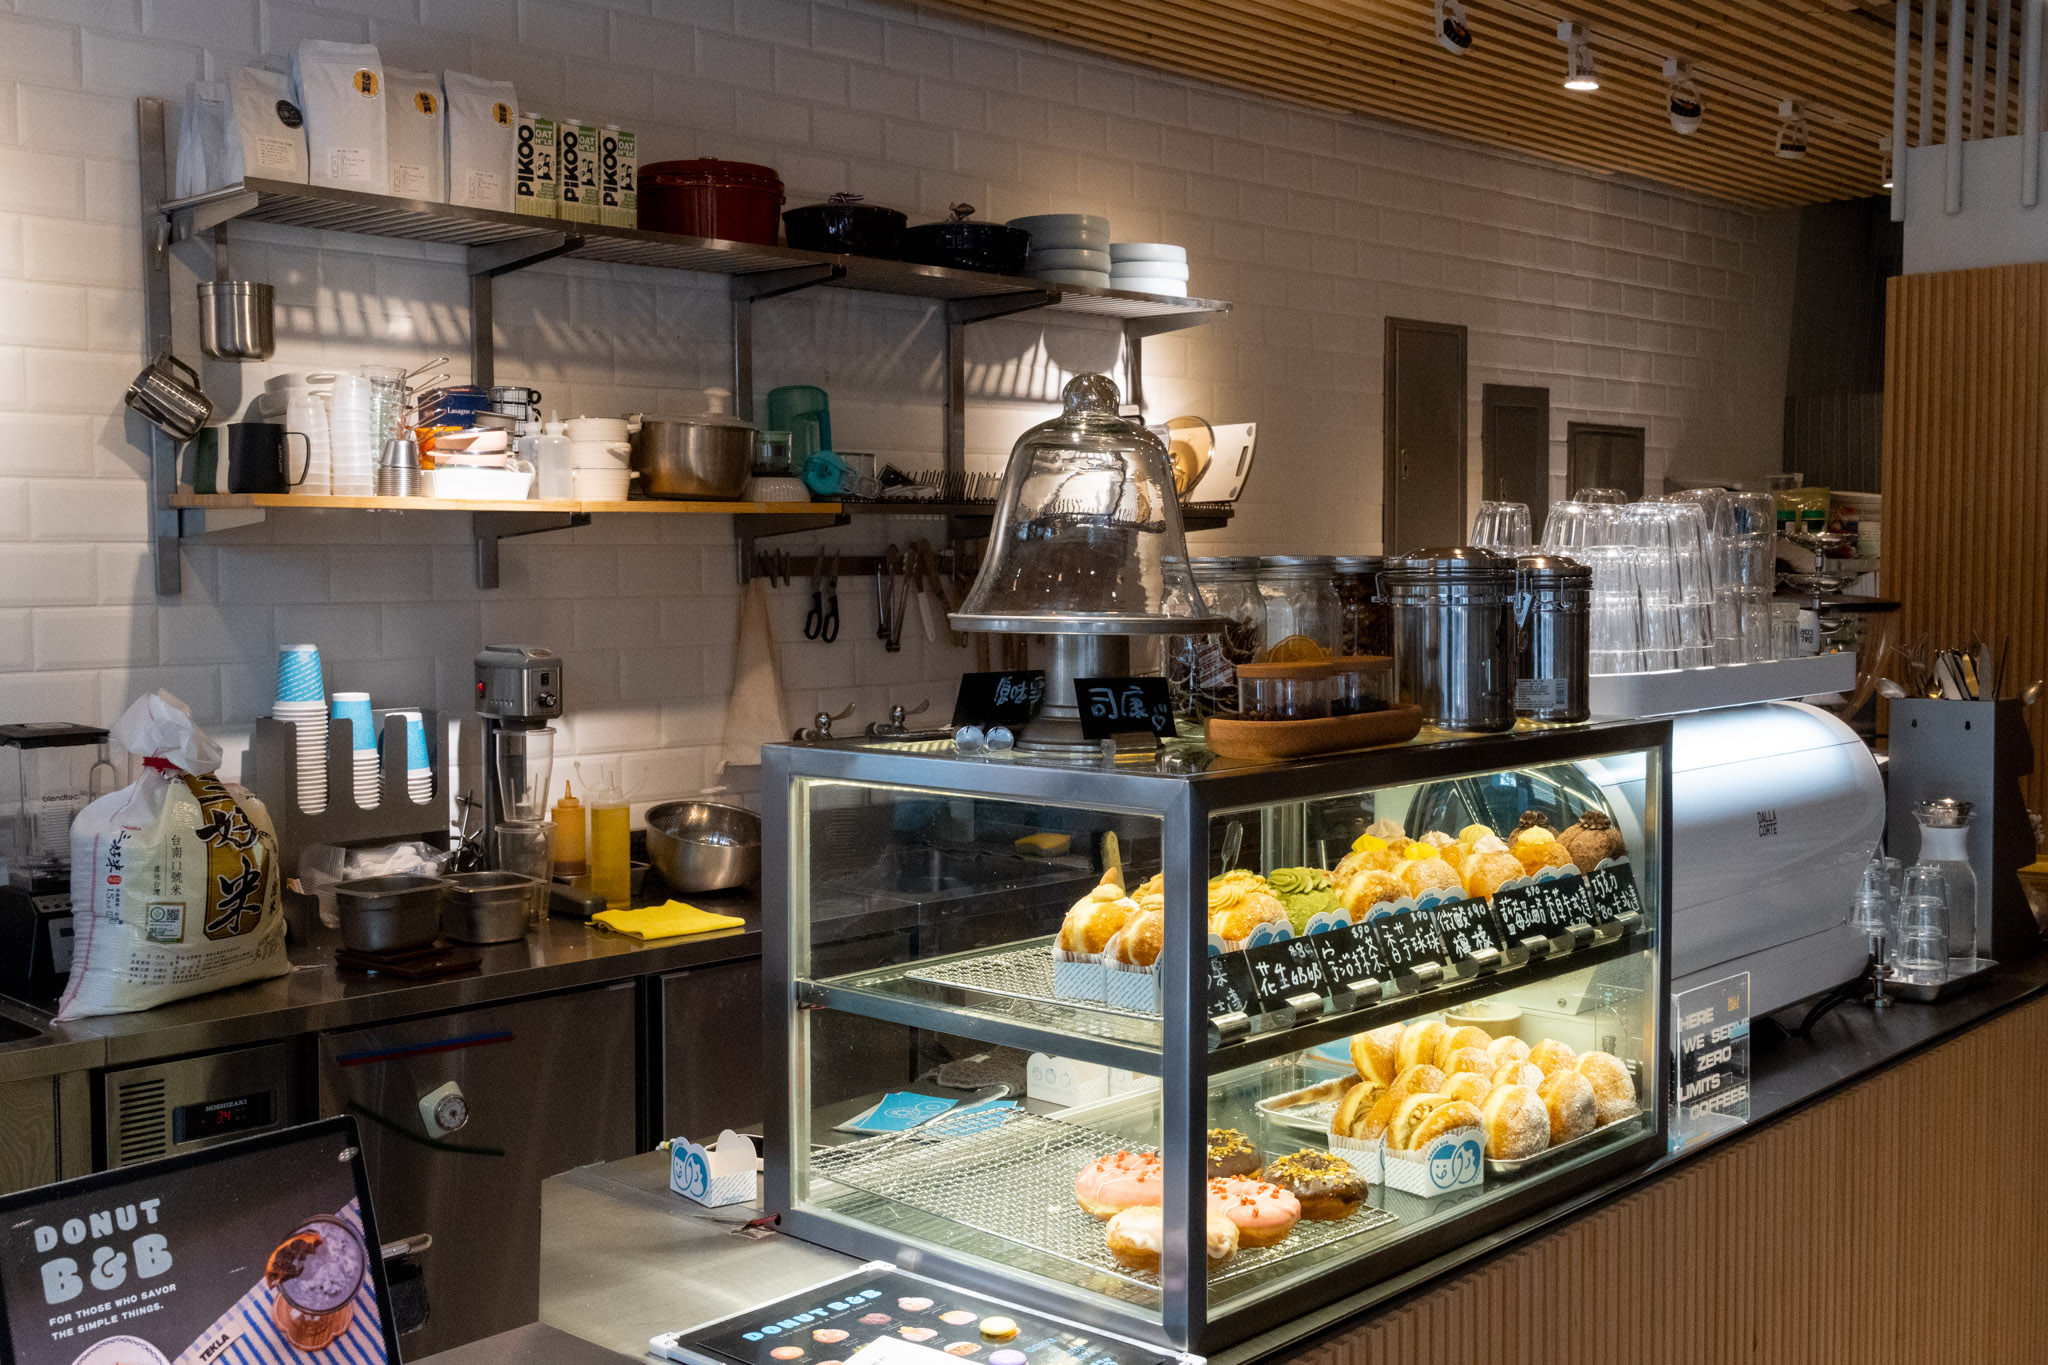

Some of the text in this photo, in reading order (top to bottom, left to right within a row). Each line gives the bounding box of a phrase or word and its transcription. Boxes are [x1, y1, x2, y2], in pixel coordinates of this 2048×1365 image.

[535, 130, 553, 140] OAT
[579, 136, 595, 145] OAT
[618, 141, 634, 150] OAT
[517, 125, 534, 197] PIKOO
[563, 131, 579, 203] PIKOO
[603, 136, 618, 207] PIKOO
[447, 407, 471, 416] Lasagne
[1088, 685, 1149, 720] 司康
[42, 794, 80, 802] blendtec
[1757, 809, 1777, 824] DALLA
[1758, 822, 1778, 837] CORTE
[1591, 871, 1618, 899] 巧克力
[1679, 1006, 1714, 1033] HERE
[1682, 1033, 1705, 1054] WE
[1697, 1045, 1732, 1072] ZERO
[1679, 1073, 1721, 1102] LIMITS
[205, 1099, 247, 1112] HOSHIZAKI
[34, 1198, 160, 1253] DONUT
[40, 1233, 173, 1305] B&B
[49, 1283, 177, 1327] FOR THOSE WHO SAVOR
[742, 1289, 883, 1342] DONUT B&B
[51, 1302, 164, 1341] THE SIMPLE THINGS.
[199, 1333, 230, 1362] TEKLA
